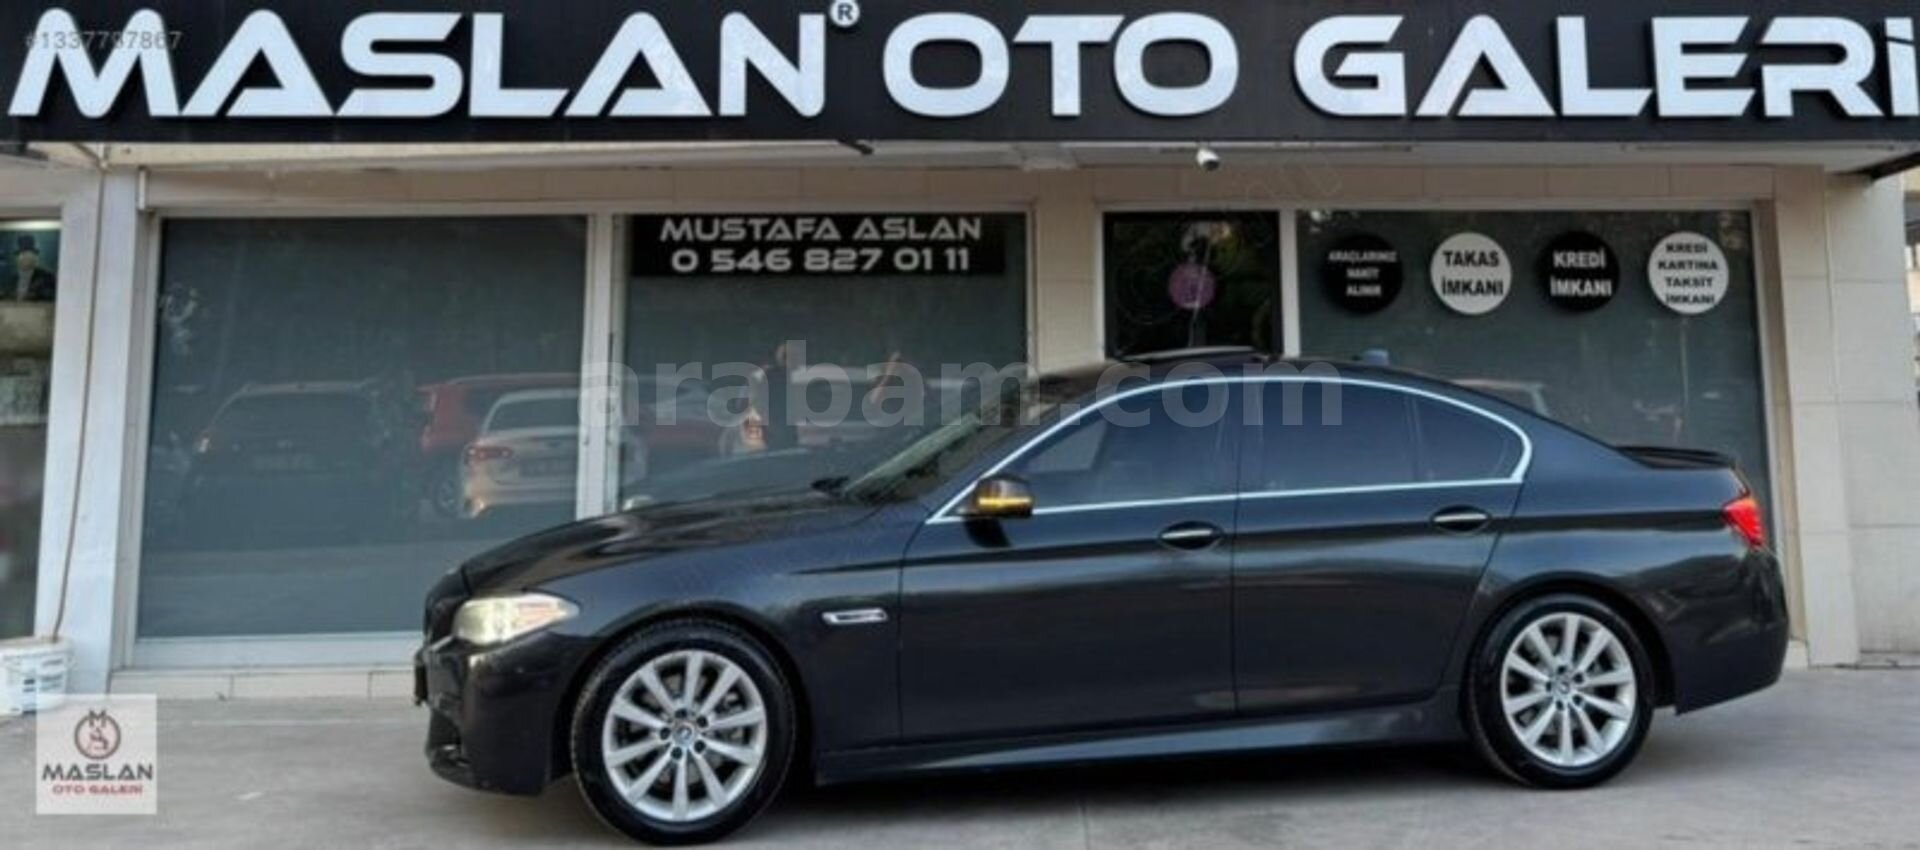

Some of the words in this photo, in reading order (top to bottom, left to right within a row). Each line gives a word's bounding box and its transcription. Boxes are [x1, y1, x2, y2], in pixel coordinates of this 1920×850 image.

[9, 9, 824, 117] MASLAN
[884, 12, 1238, 116] OTO
[661, 218, 841, 241] MUSTAFA
[853, 218, 980, 240] ASLAN
[1553, 248, 1606, 268] KREDİ
[1665, 243, 1708, 253] KREDİ
[711, 249, 792, 272] 546
[804, 248, 882, 271] 827
[894, 248, 932, 271] 01
[946, 248, 969, 270] 11
[1443, 251, 1500, 267] TAKAS
[1657, 260, 1718, 271] KARTINA
[1441, 277, 1504, 296] İMKANI
[1550, 276, 1612, 296] İMKANI
